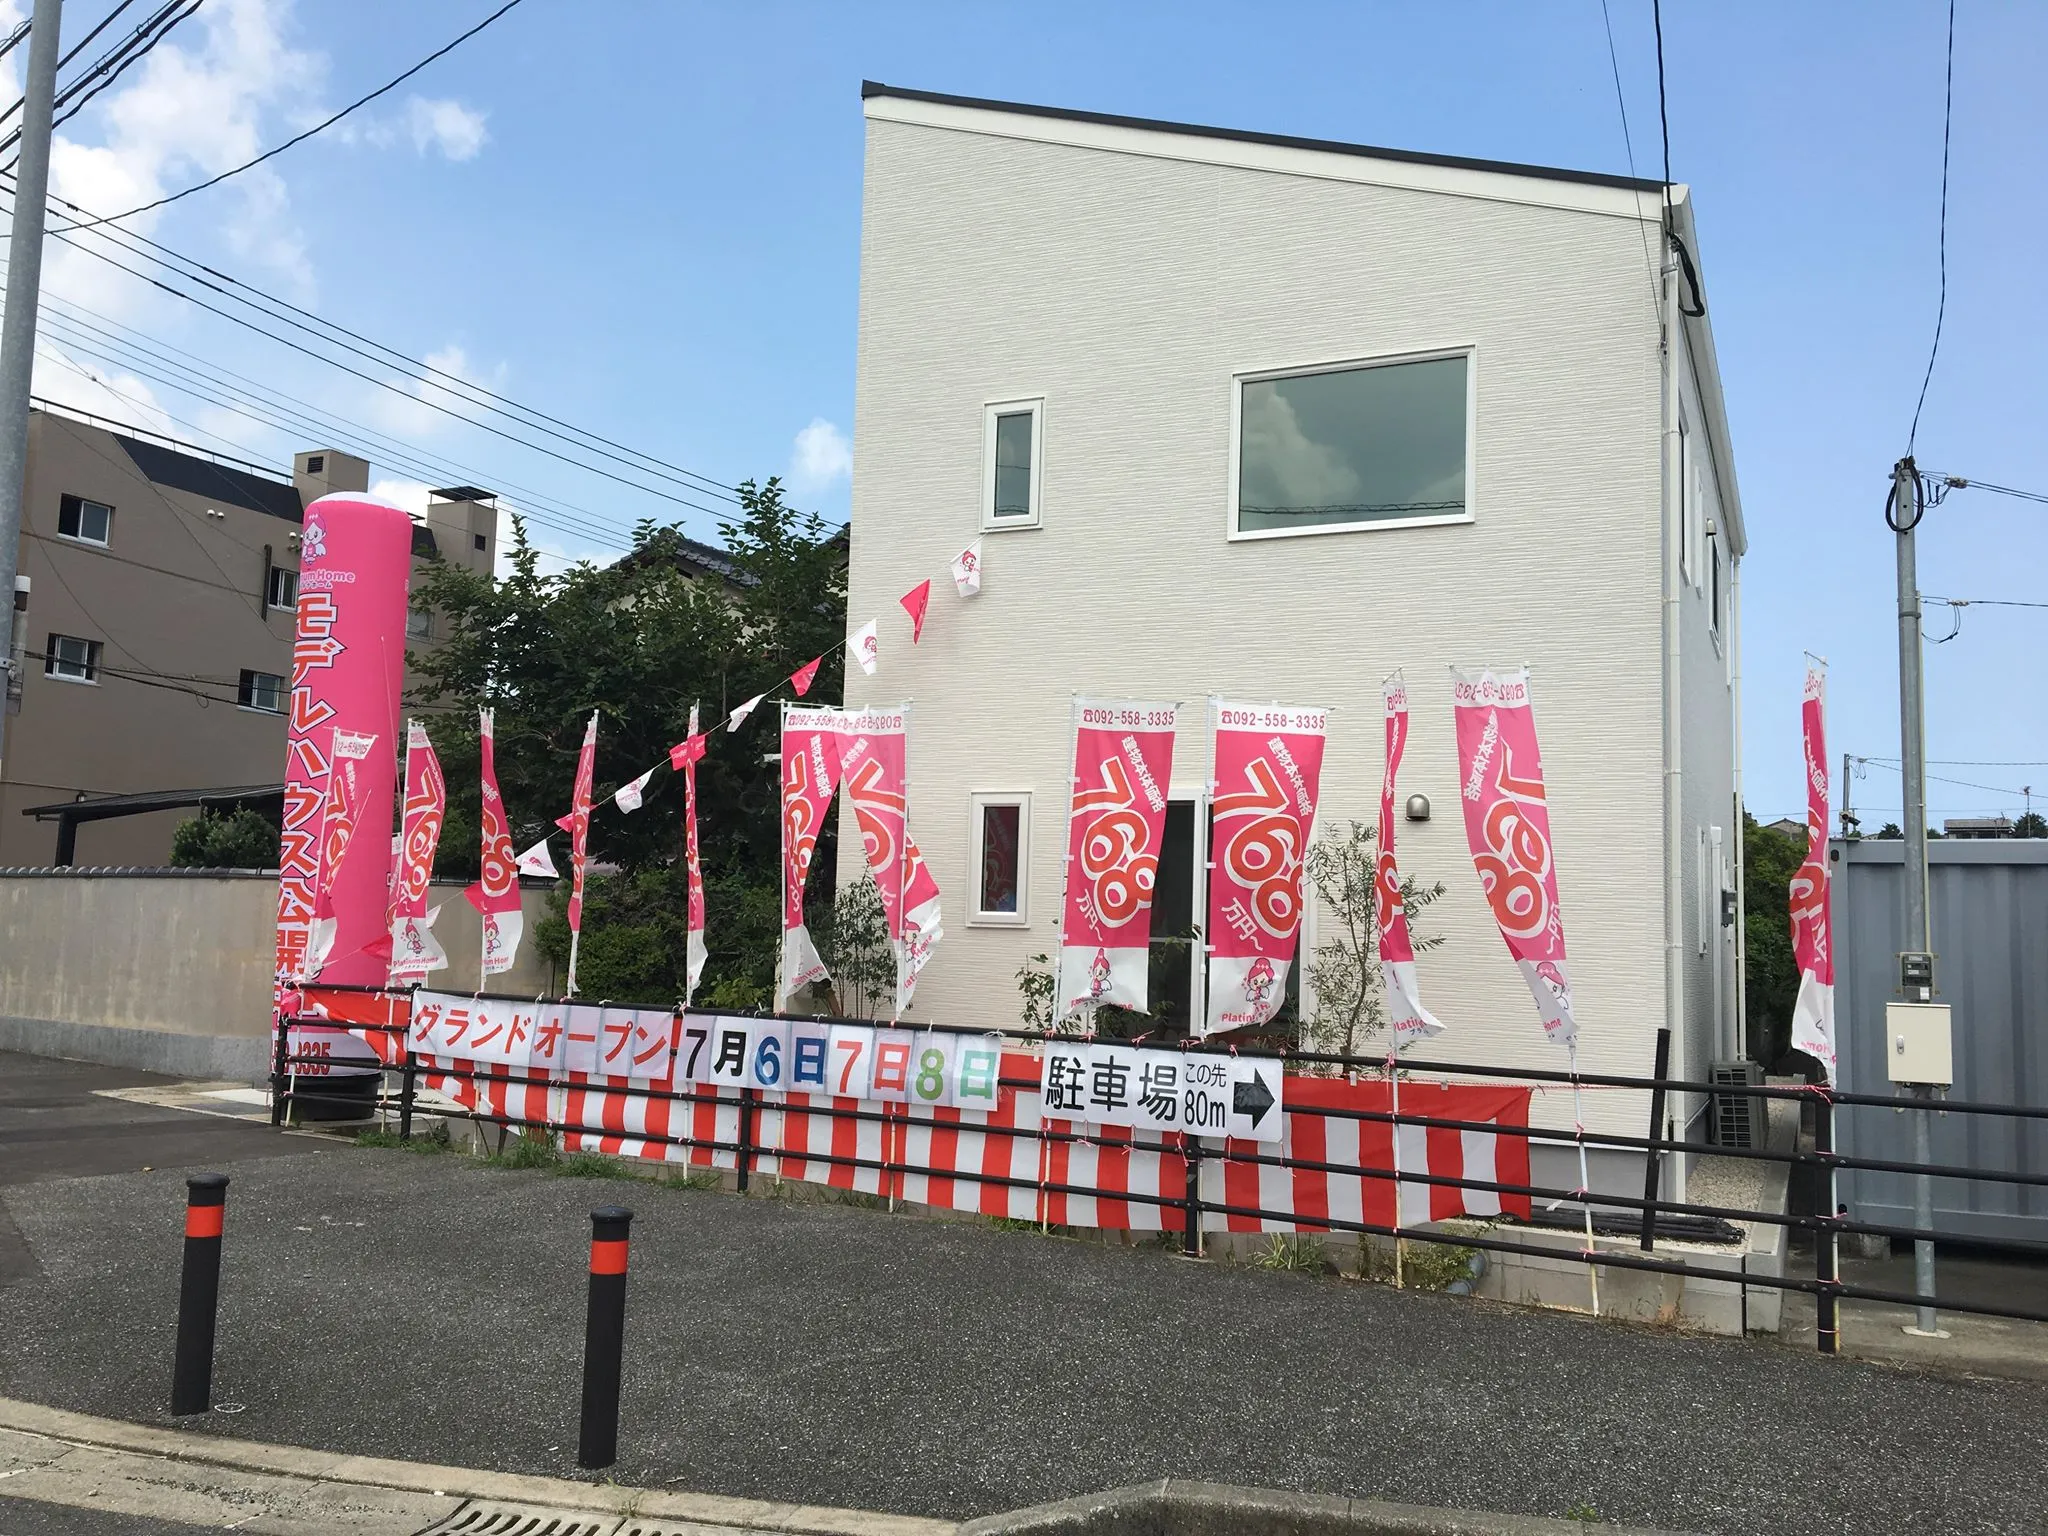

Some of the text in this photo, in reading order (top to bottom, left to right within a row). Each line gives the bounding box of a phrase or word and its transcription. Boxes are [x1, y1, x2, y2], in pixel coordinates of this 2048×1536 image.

[1094, 709, 1174, 726] 092-558-3335
[1234, 711, 1325, 729] 092-558-3335
[1122, 735, 1165, 813] 建物本体価格
[1267, 736, 1313, 817] 建物本体価格
[1072, 756, 1159, 928] 768
[1213, 756, 1304, 938] 768
[414, 1004, 667, 1067] グランドオープン
[1045, 1055, 1179, 1122] 駐車場
[1185, 1062, 1227, 1088] この先
[1184, 1089, 1226, 1128] 80m
